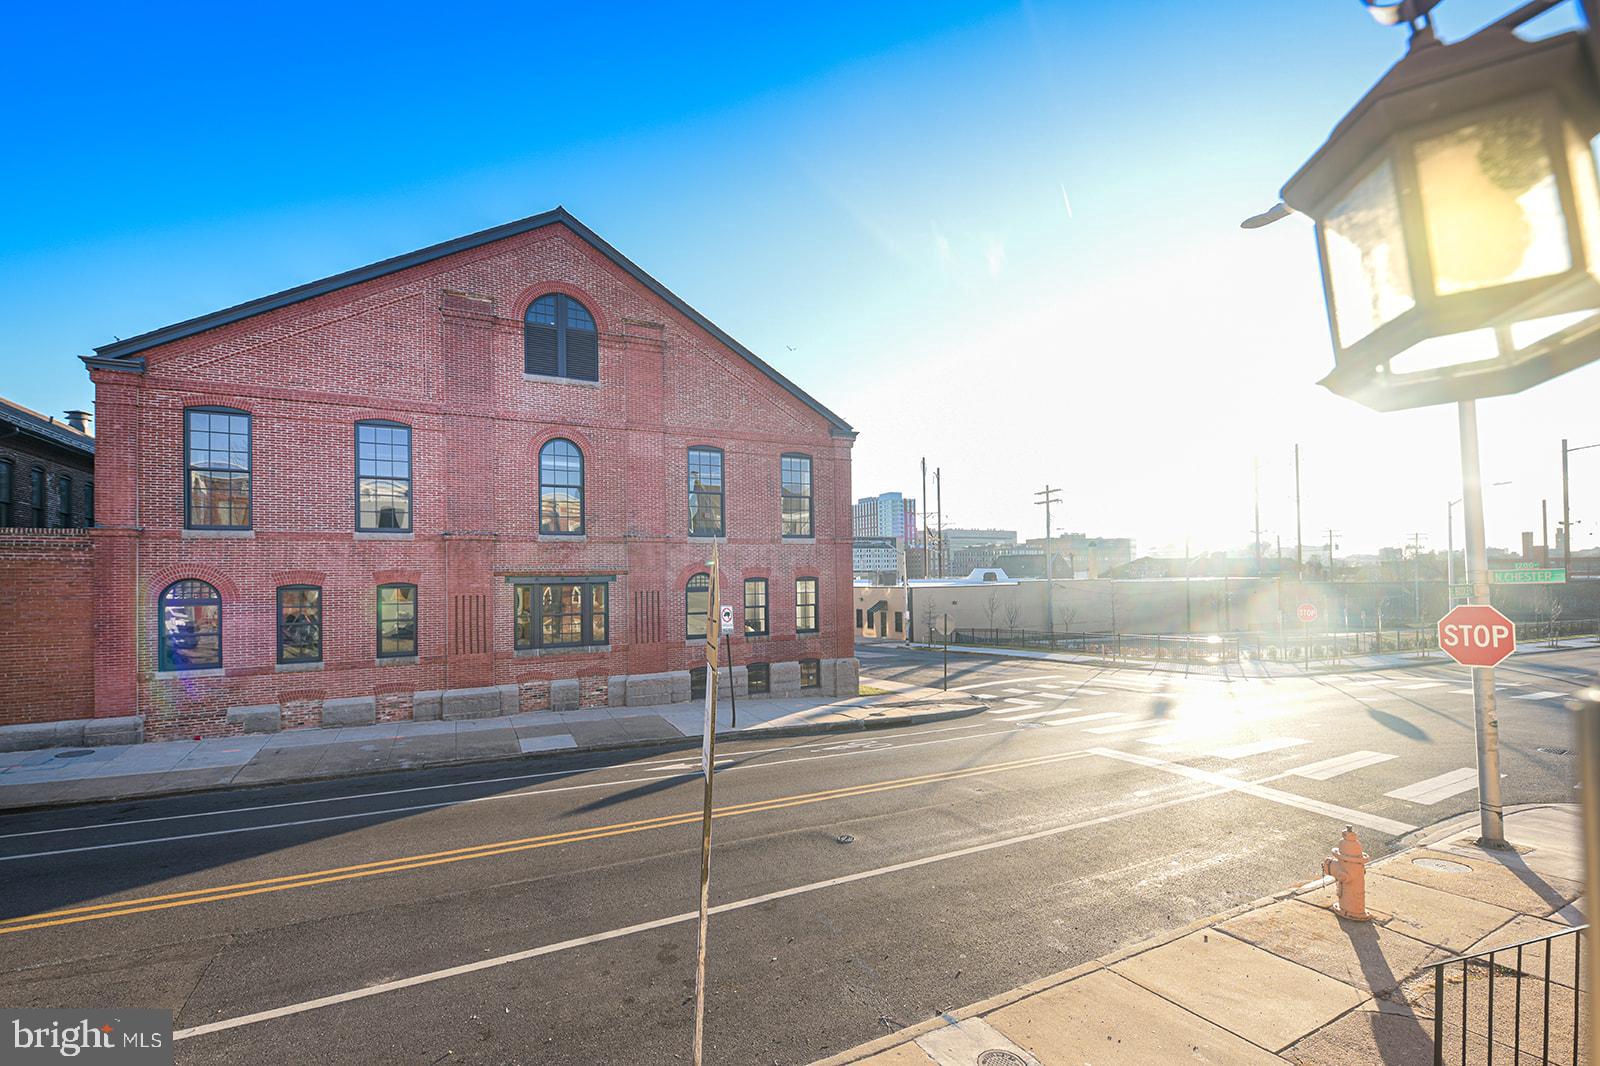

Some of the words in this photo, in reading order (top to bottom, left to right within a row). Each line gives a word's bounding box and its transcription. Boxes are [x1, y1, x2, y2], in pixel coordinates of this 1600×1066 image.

[1495, 572, 1502, 582] N
[1504, 571, 1552, 582] CHESTER
[1299, 608, 1315, 617] STOP
[1443, 624, 1509, 648] STOP
